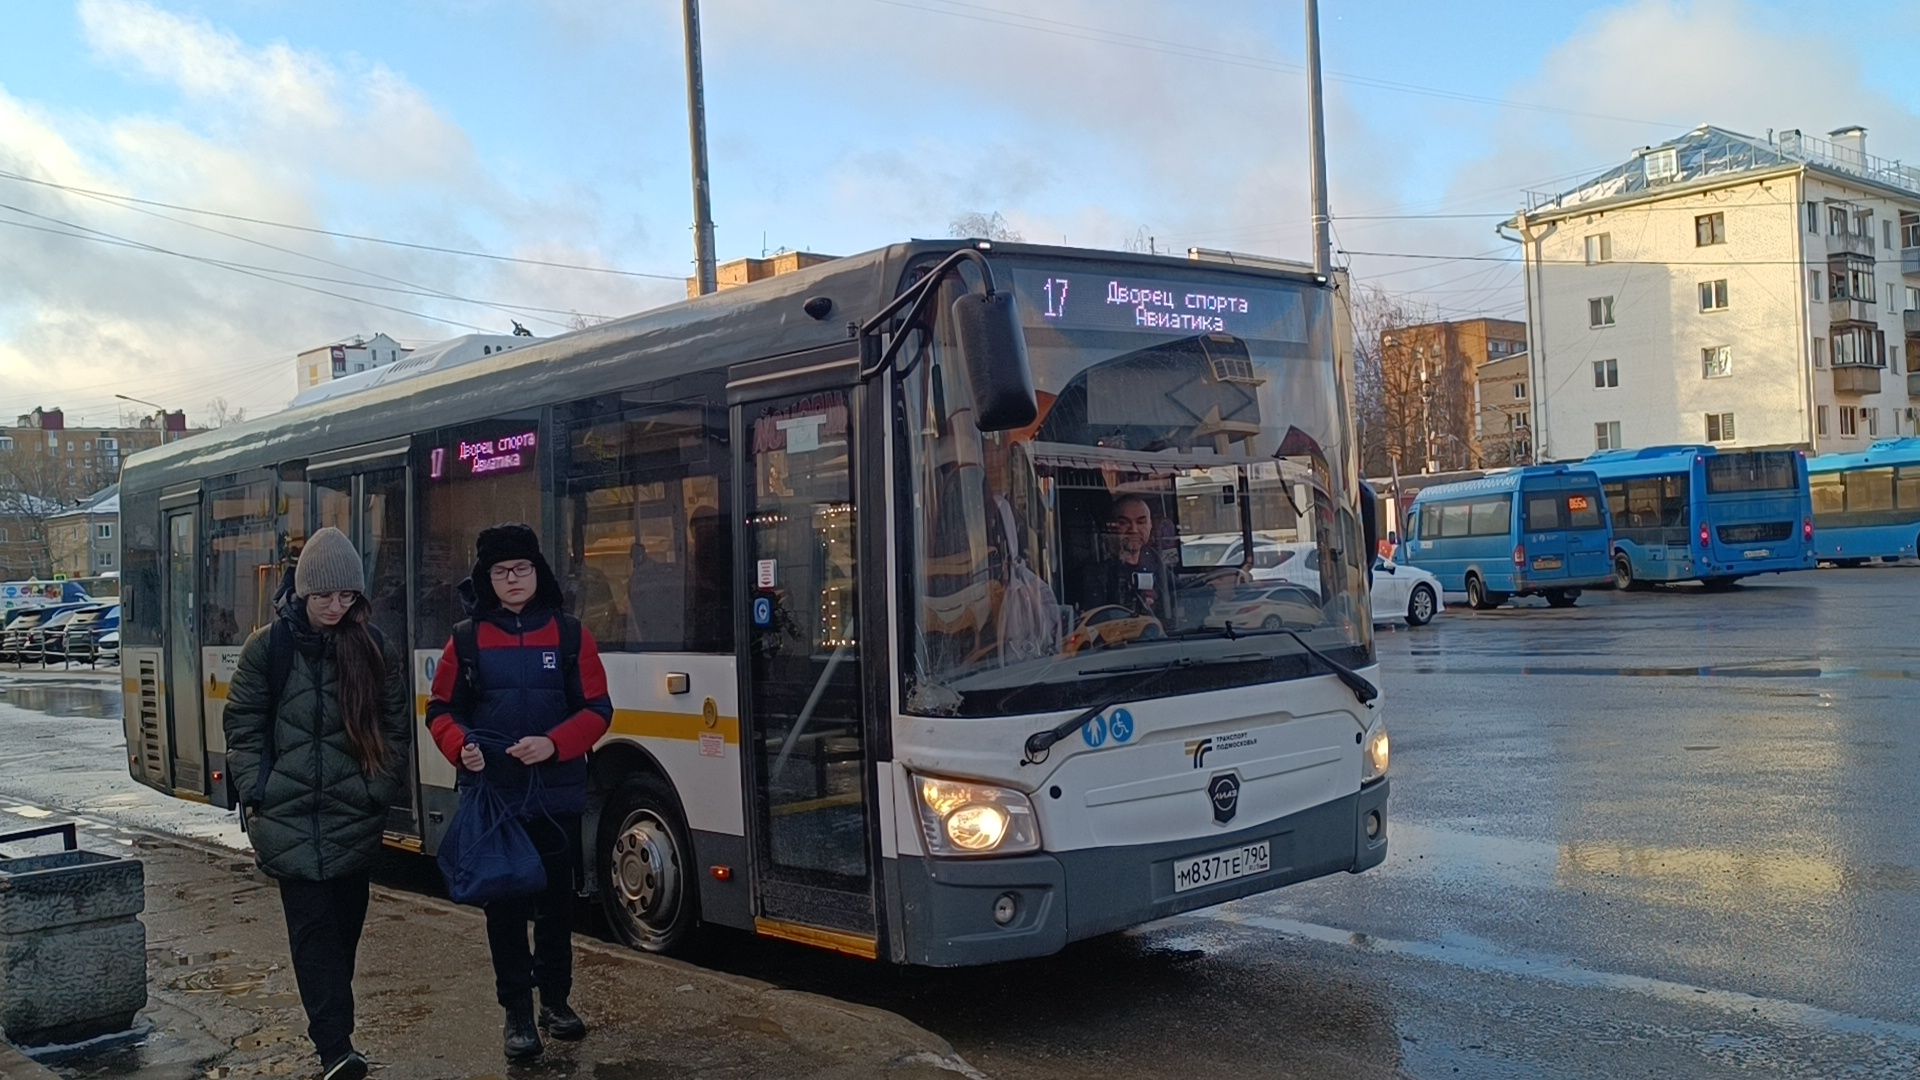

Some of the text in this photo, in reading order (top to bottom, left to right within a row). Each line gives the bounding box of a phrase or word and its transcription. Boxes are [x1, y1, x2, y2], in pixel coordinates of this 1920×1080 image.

[1043, 278, 1069, 318] 17
[1106, 280, 1249, 313] Дворец спорта
[1136, 307, 1224, 332] Авиатика
[459, 432, 536, 460] Дворец спорта
[1216, 732, 1247, 742] ТРАНСПОРТ
[1216, 738, 1257, 750] ПОДМОСКОВЬЯ
[1213, 789, 1237, 801] ЛИАЗ
[1243, 845, 1266, 866] 790
